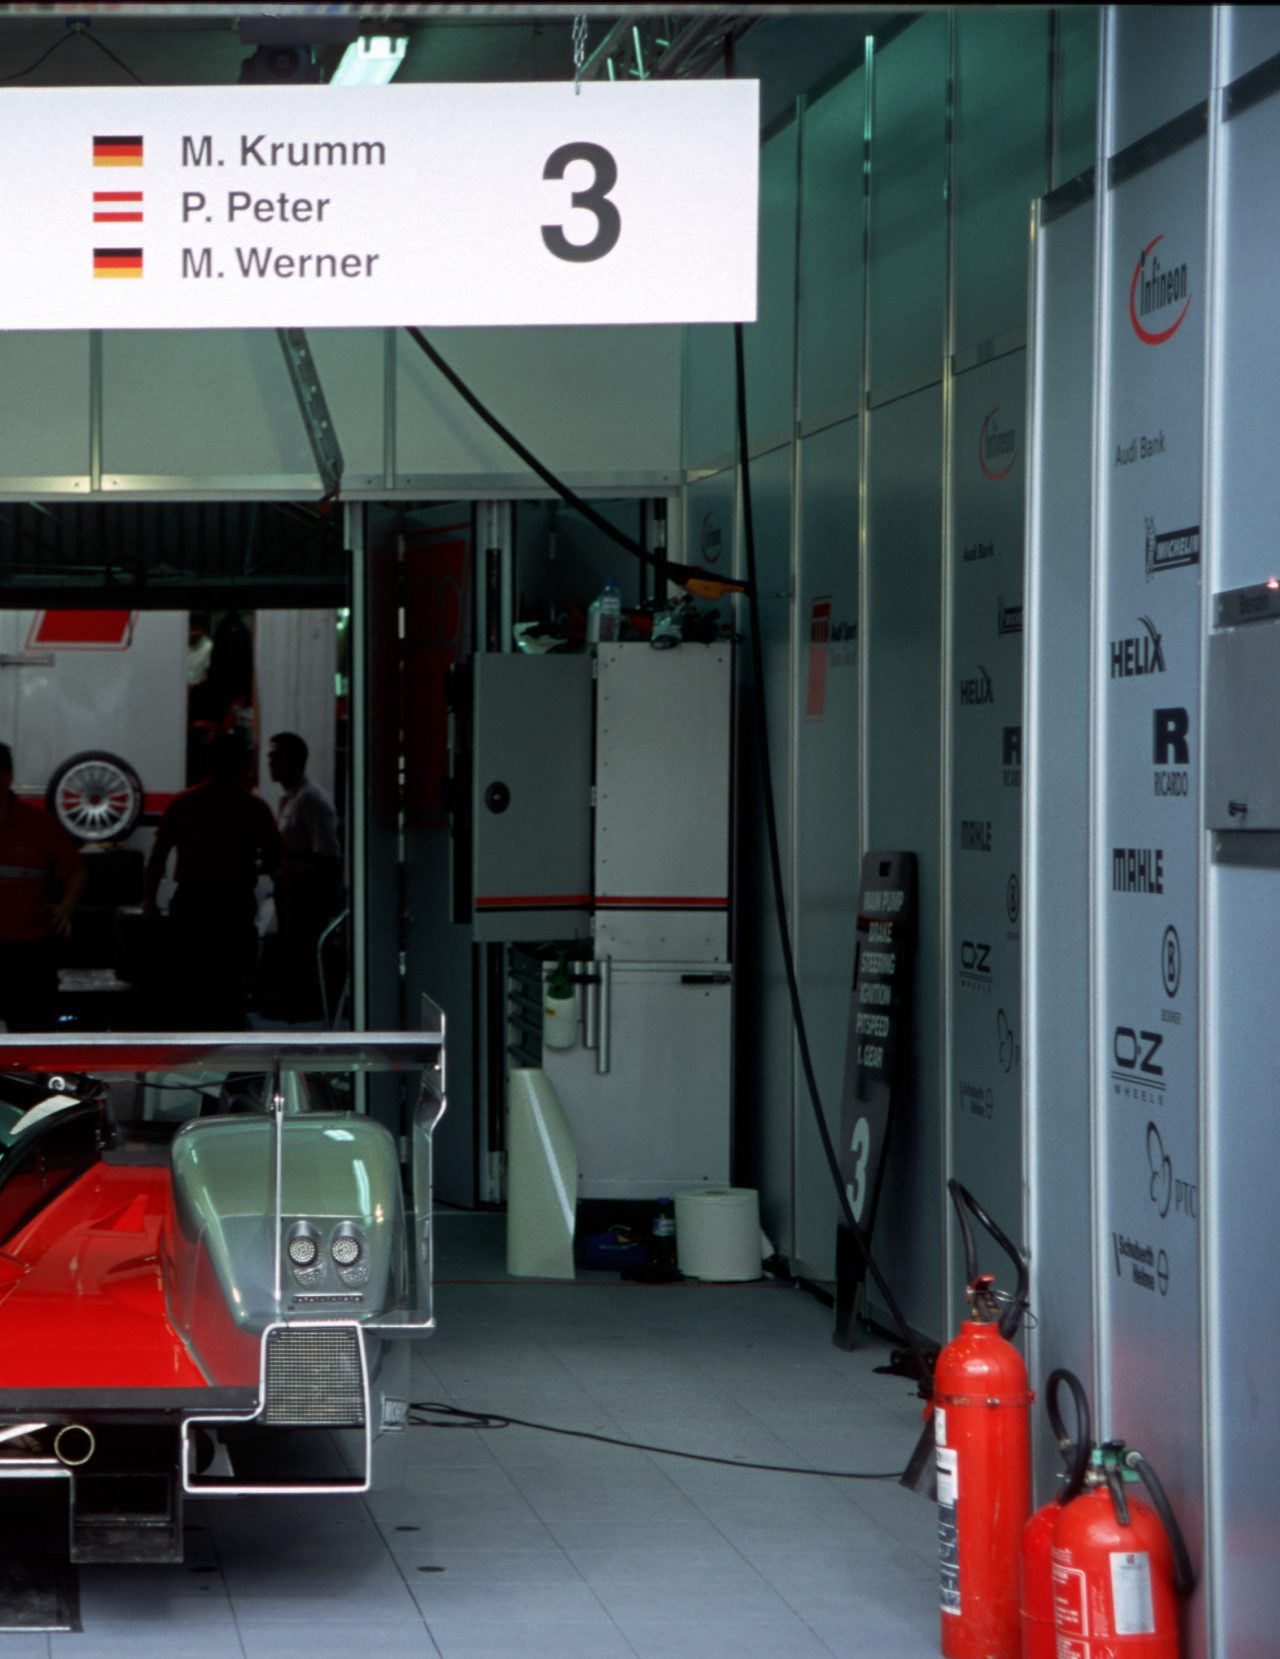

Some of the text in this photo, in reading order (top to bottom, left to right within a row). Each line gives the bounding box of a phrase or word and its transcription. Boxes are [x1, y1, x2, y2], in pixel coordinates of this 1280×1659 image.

[182, 134, 386, 167] M. Krumm
[182, 191, 331, 223] P. Peter
[540, 141, 622, 264] 3
[182, 247, 380, 278] M. Werner
[1115, 430, 1166, 467] Audi Bank
[1111, 633, 1165, 679] HELIX
[961, 677, 994, 705] HELIX
[1152, 707, 1190, 765] R
[1153, 771, 1188, 797] RICARDO
[961, 820, 992, 852] MAHLE
[1113, 848, 1163, 895] MAHLE
[863, 890, 905, 913] MAIN PUMP
[868, 920, 894, 943] BRAKE
[860, 951, 897, 976] STEERING
[859, 981, 892, 1006] IGNITION
[855, 1012, 890, 1038] PITSPEED
[863, 1044, 884, 1069] GEAR
[1114, 1083, 1166, 1106] WHEELS
[846, 1116, 871, 1224] 3
[1175, 1178, 1197, 1218] PTC
